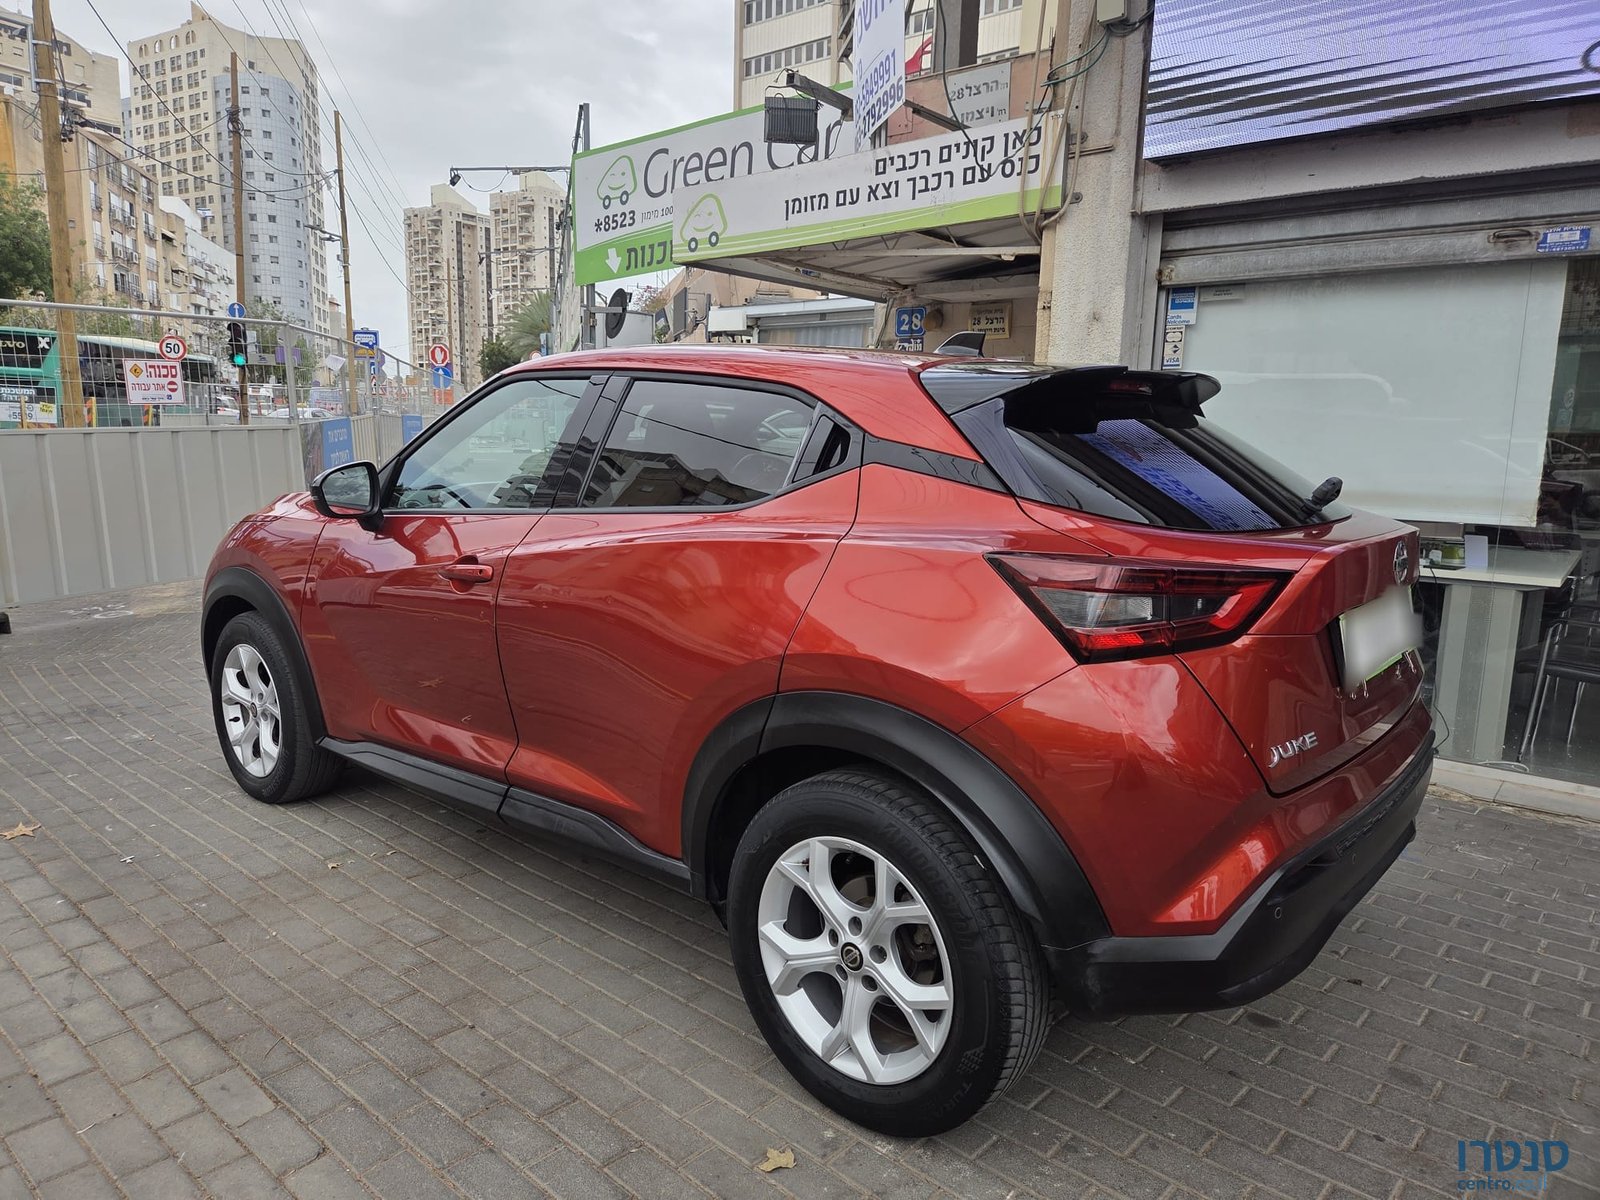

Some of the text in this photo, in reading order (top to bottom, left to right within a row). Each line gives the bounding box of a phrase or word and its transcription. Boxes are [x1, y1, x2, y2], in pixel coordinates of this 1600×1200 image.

[874, 125, 1042, 176] כאן קונים רכבים
[643, 141, 755, 199] Green
[785, 154, 1041, 221] כנס עם רכבך וצא עם מזומן
[900, 312, 921, 331] 28
[165, 343, 181, 355] 50
[145, 362, 178, 379] סכנה!
[131, 382, 166, 391] אתר עבודה
[1268, 731, 1319, 768] JUKE
